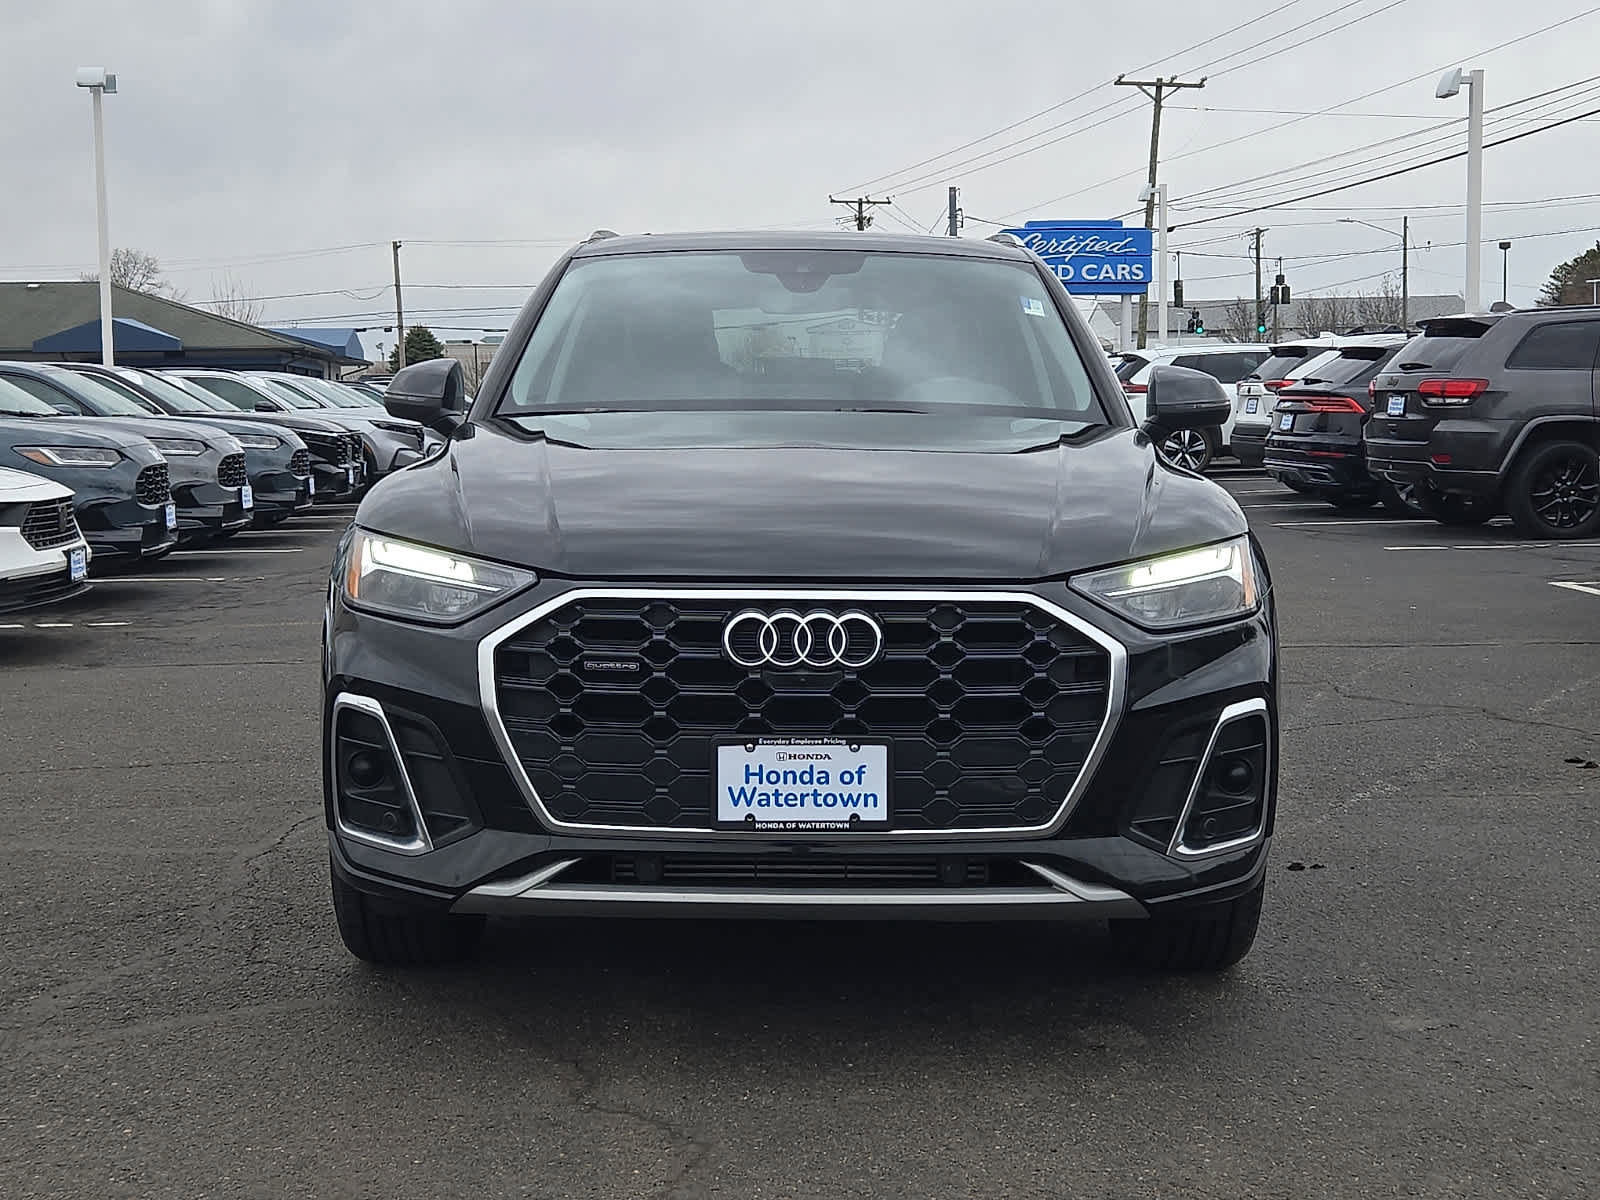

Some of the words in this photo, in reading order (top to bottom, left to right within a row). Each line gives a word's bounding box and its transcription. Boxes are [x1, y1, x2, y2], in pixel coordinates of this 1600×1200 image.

[1023, 233, 1137, 262] Certified
[1081, 264, 1144, 280] CARS
[745, 764, 830, 785] Honda
[839, 765, 867, 785] of
[728, 786, 878, 808] Watertown
